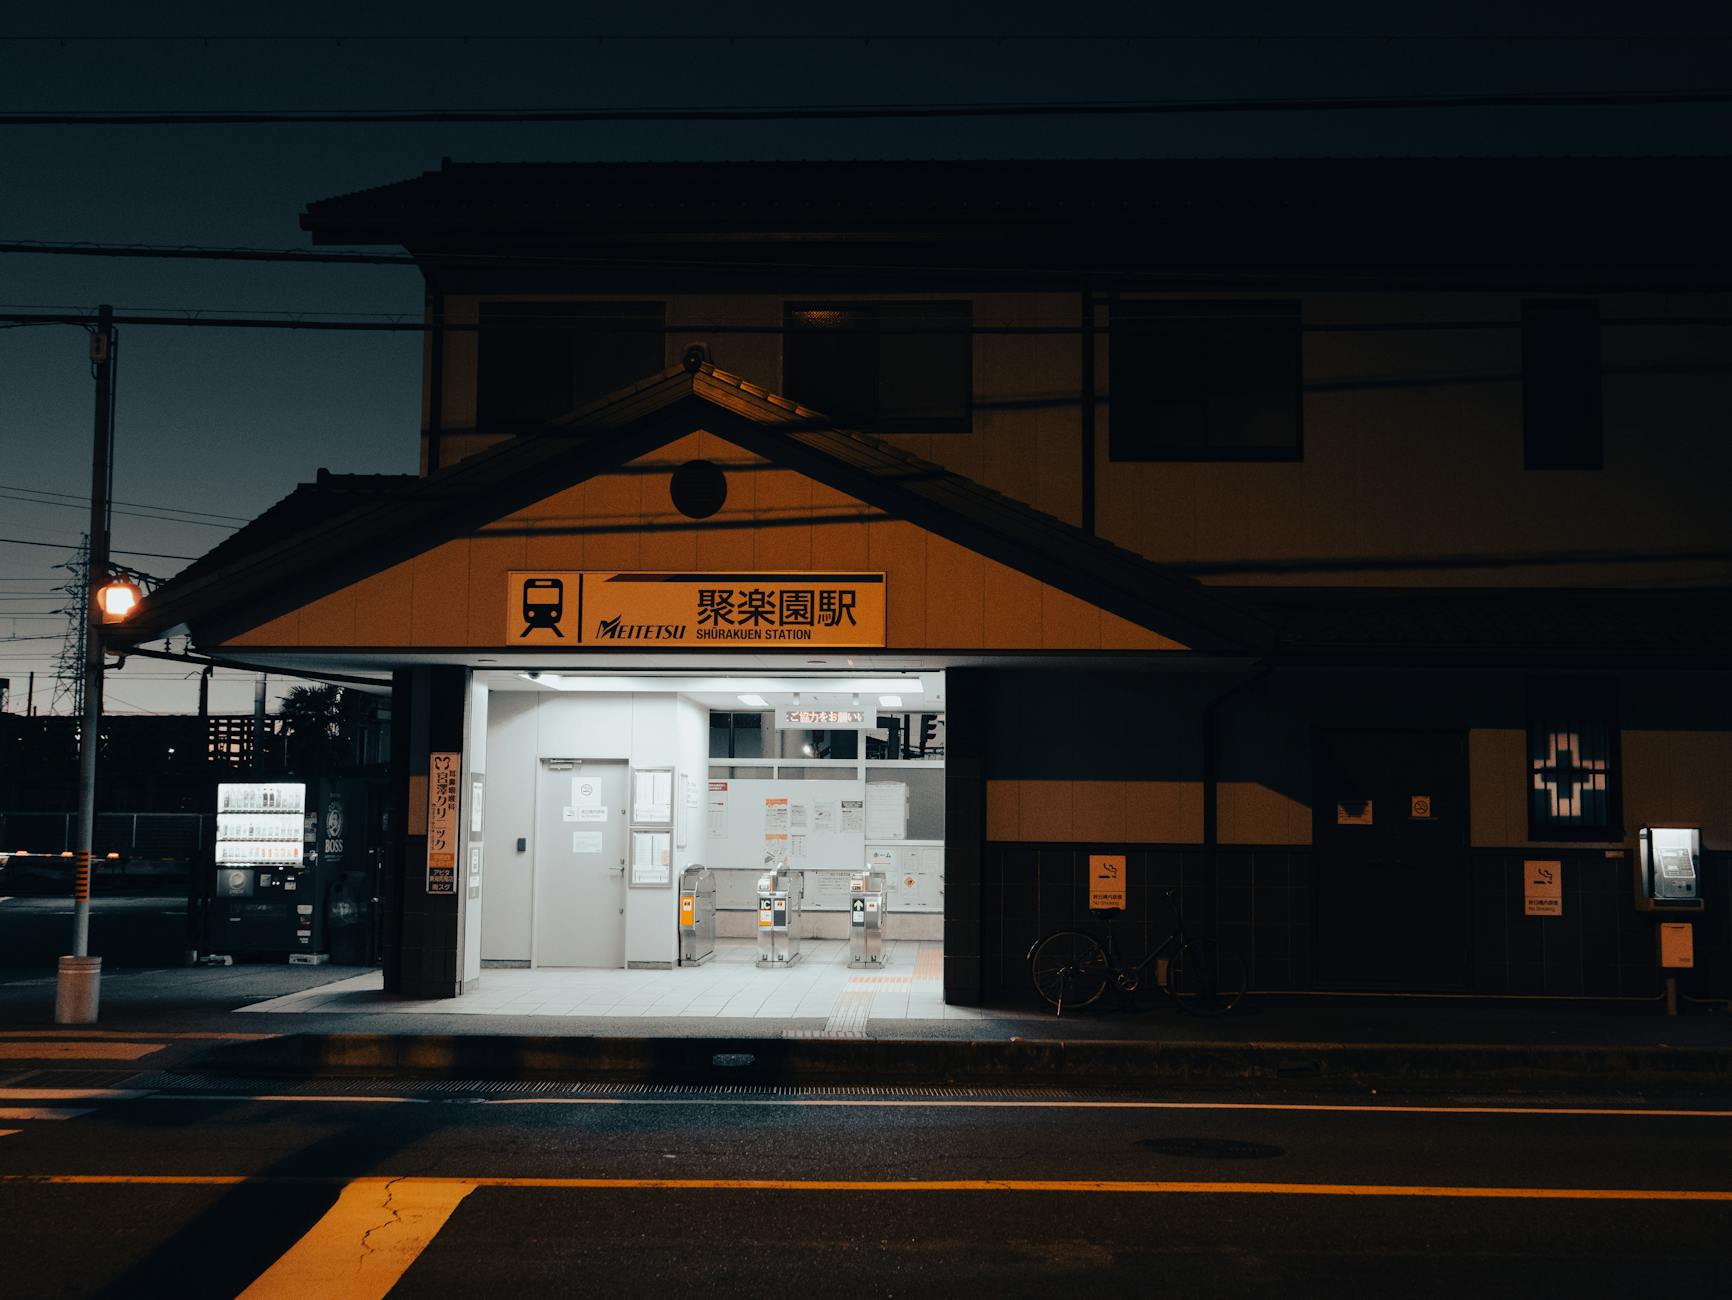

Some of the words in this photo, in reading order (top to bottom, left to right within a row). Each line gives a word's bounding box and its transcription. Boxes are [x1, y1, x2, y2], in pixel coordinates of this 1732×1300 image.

[696, 588, 857, 627] 聚楽園駅
[596, 614, 686, 640] MEITETSU
[696, 626, 762, 640] SHŪRAKUEN
[765, 629, 811, 640] STATION
[325, 839, 343, 853] BOSS
[760, 900, 771, 910] IC
